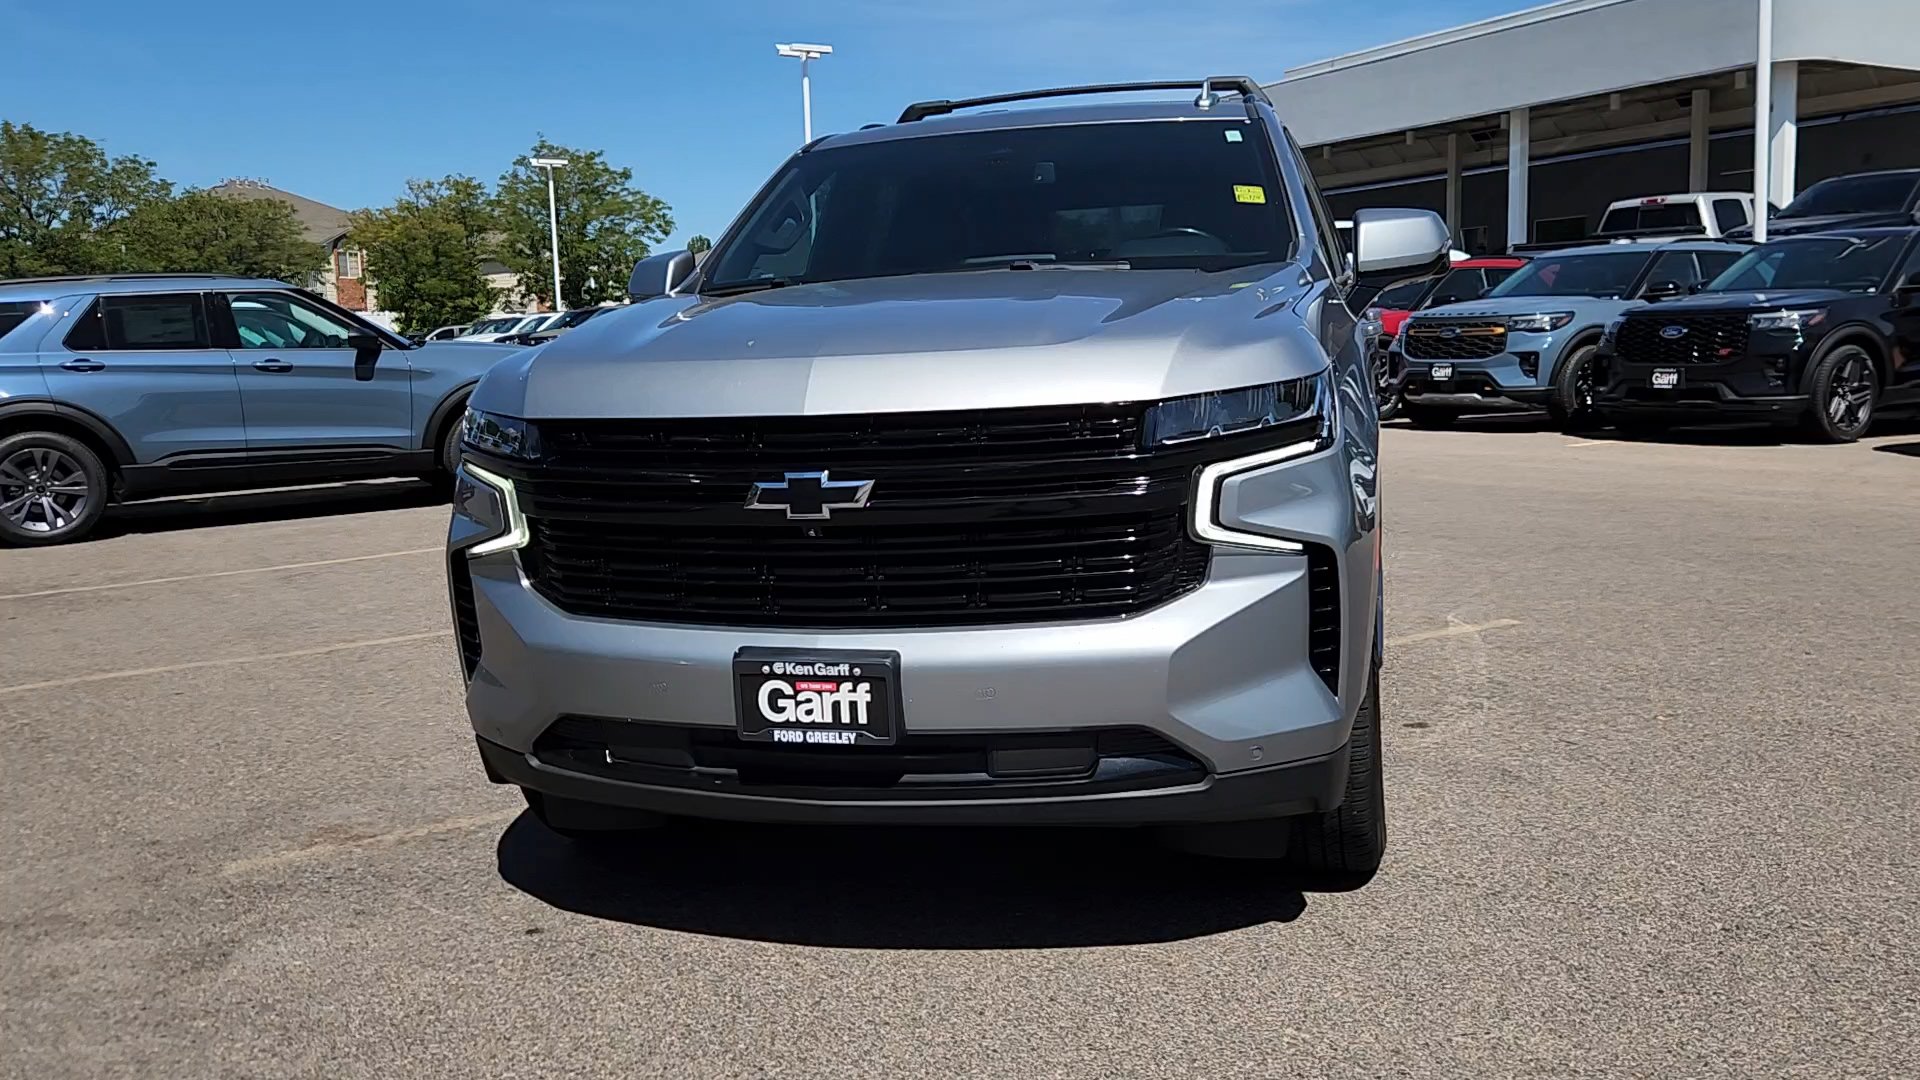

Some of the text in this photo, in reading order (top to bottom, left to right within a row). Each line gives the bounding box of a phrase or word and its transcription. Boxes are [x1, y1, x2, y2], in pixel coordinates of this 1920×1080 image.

[1652, 372, 1678, 384] Garff
[785, 662, 850, 676] Ken Garff
[758, 679, 871, 724] Garff
[773, 730, 857, 744] FORD GREELEY
